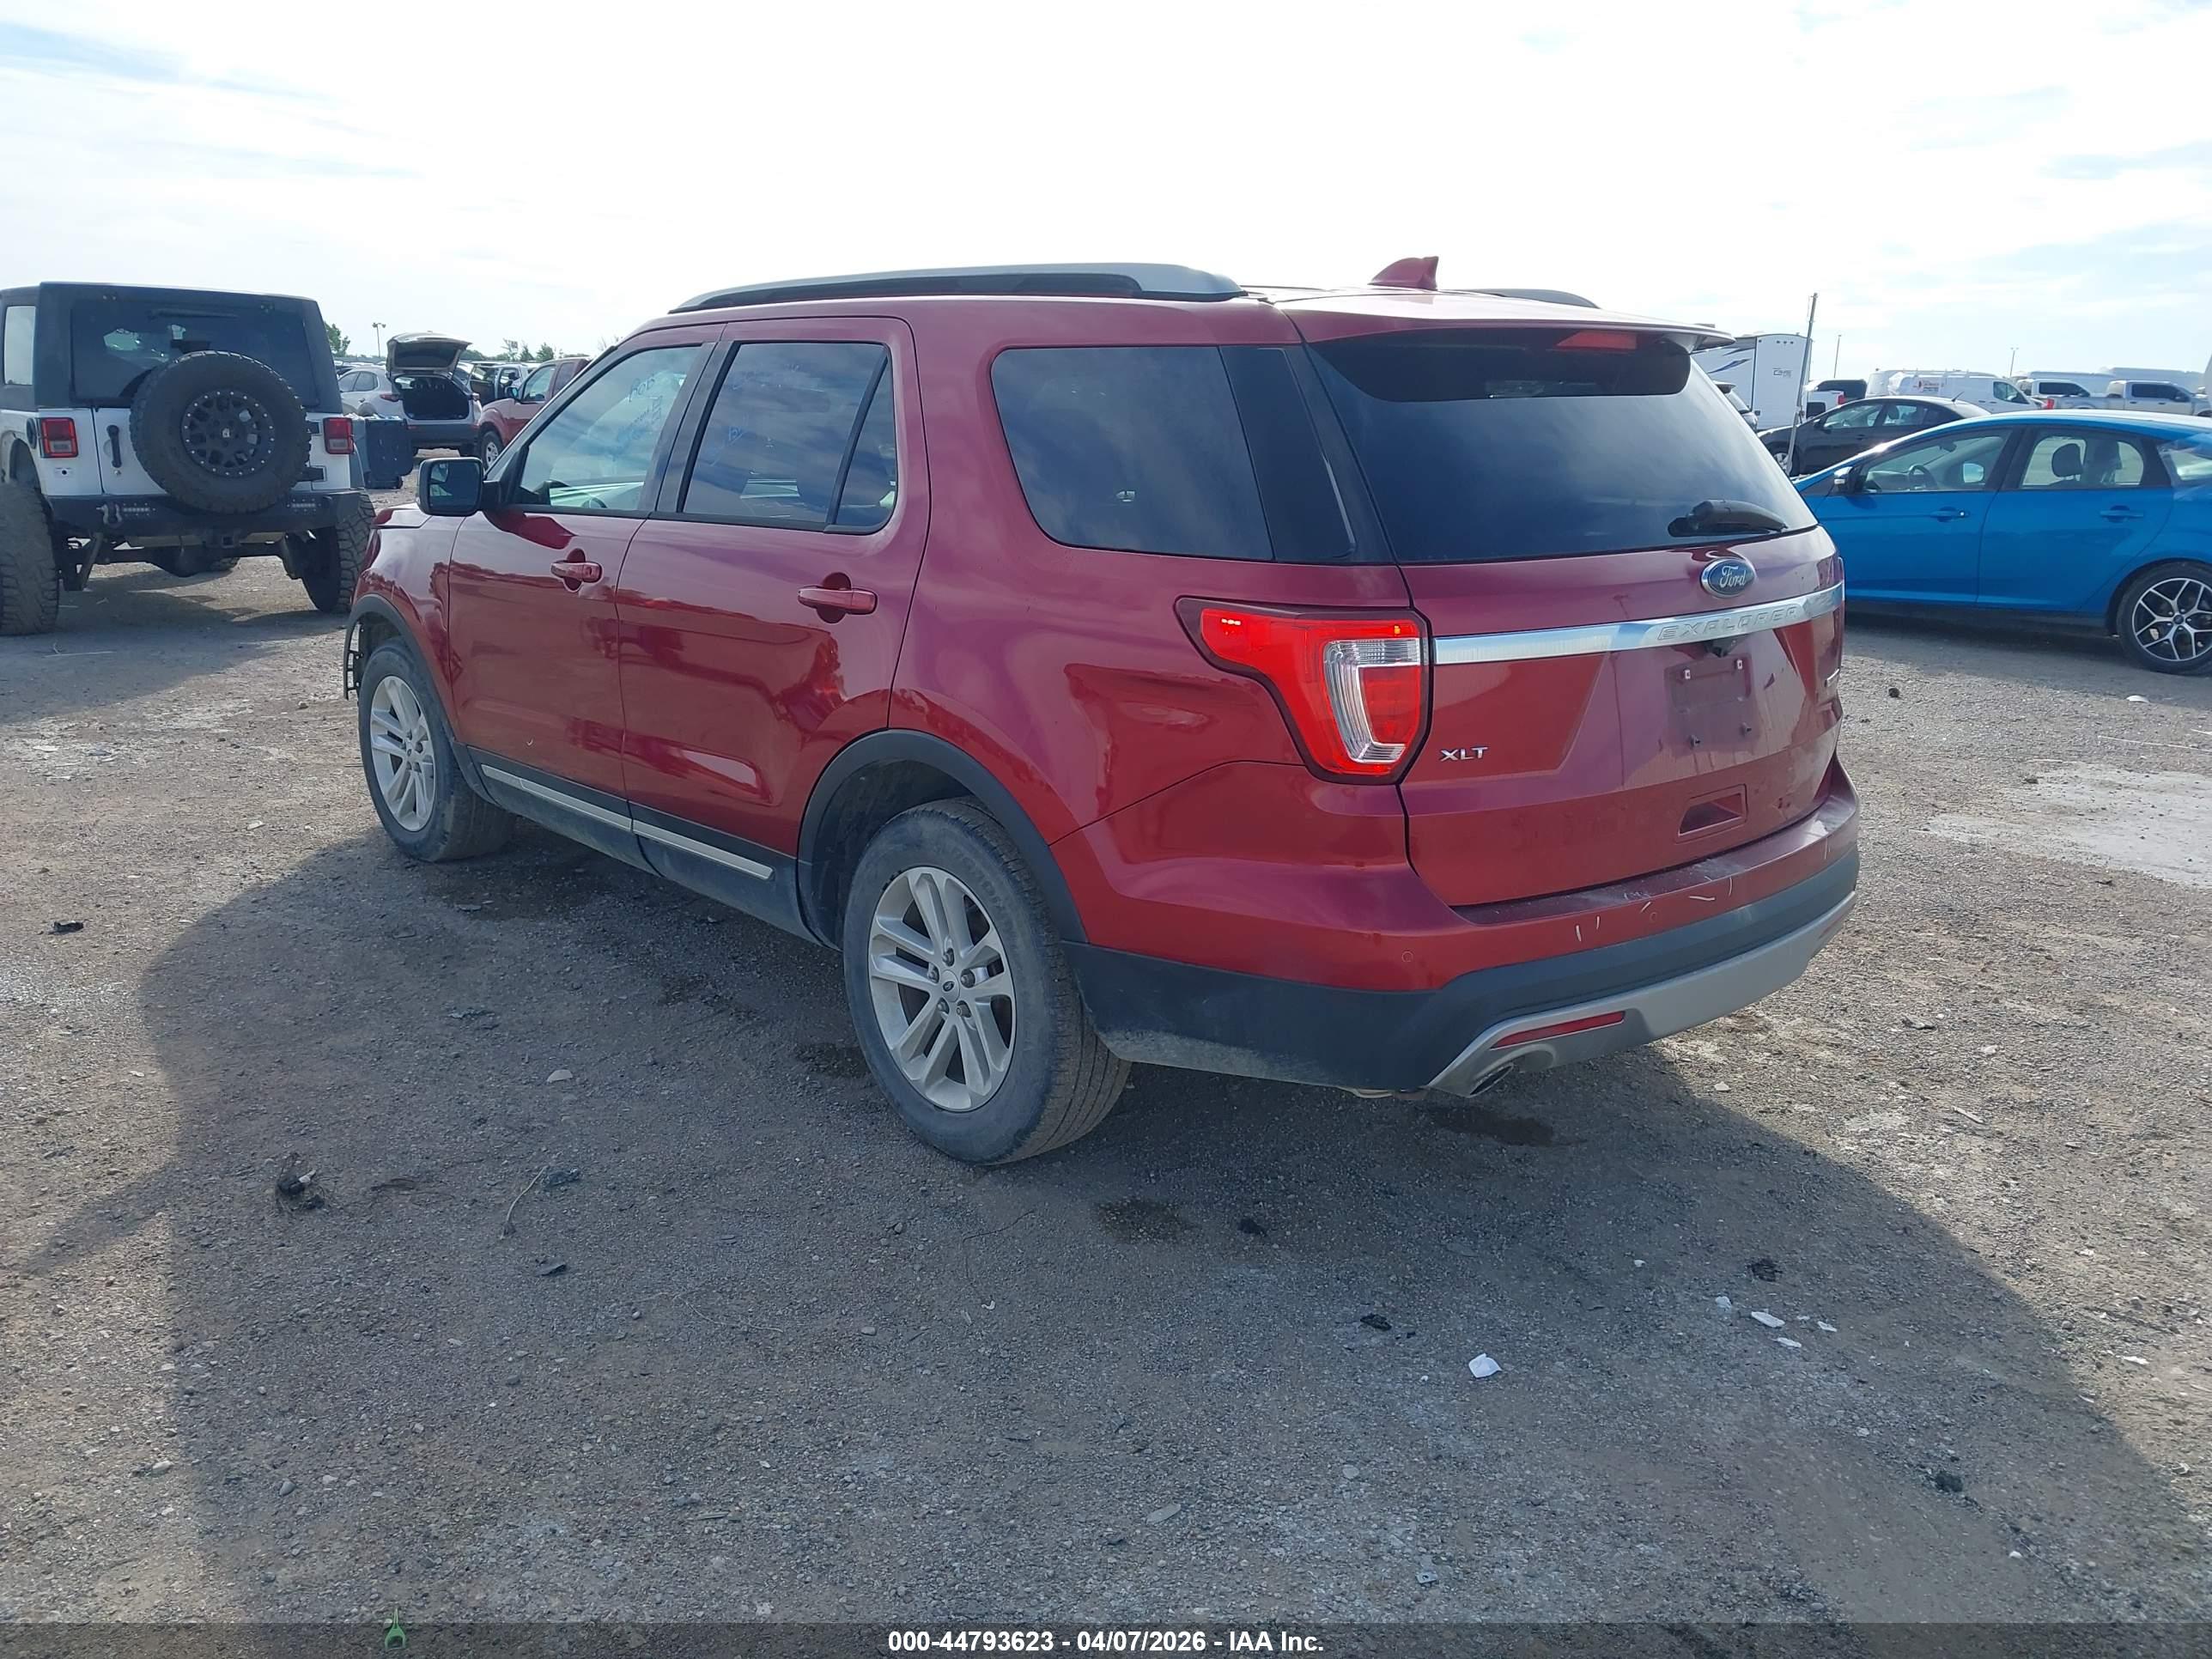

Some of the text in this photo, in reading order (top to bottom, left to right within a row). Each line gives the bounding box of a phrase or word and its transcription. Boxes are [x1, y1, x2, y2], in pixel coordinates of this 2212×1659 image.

[1719, 565, 1747, 588] Ford
[1657, 604, 1797, 641] EXPLORER
[1440, 746, 1488, 762] XLT
